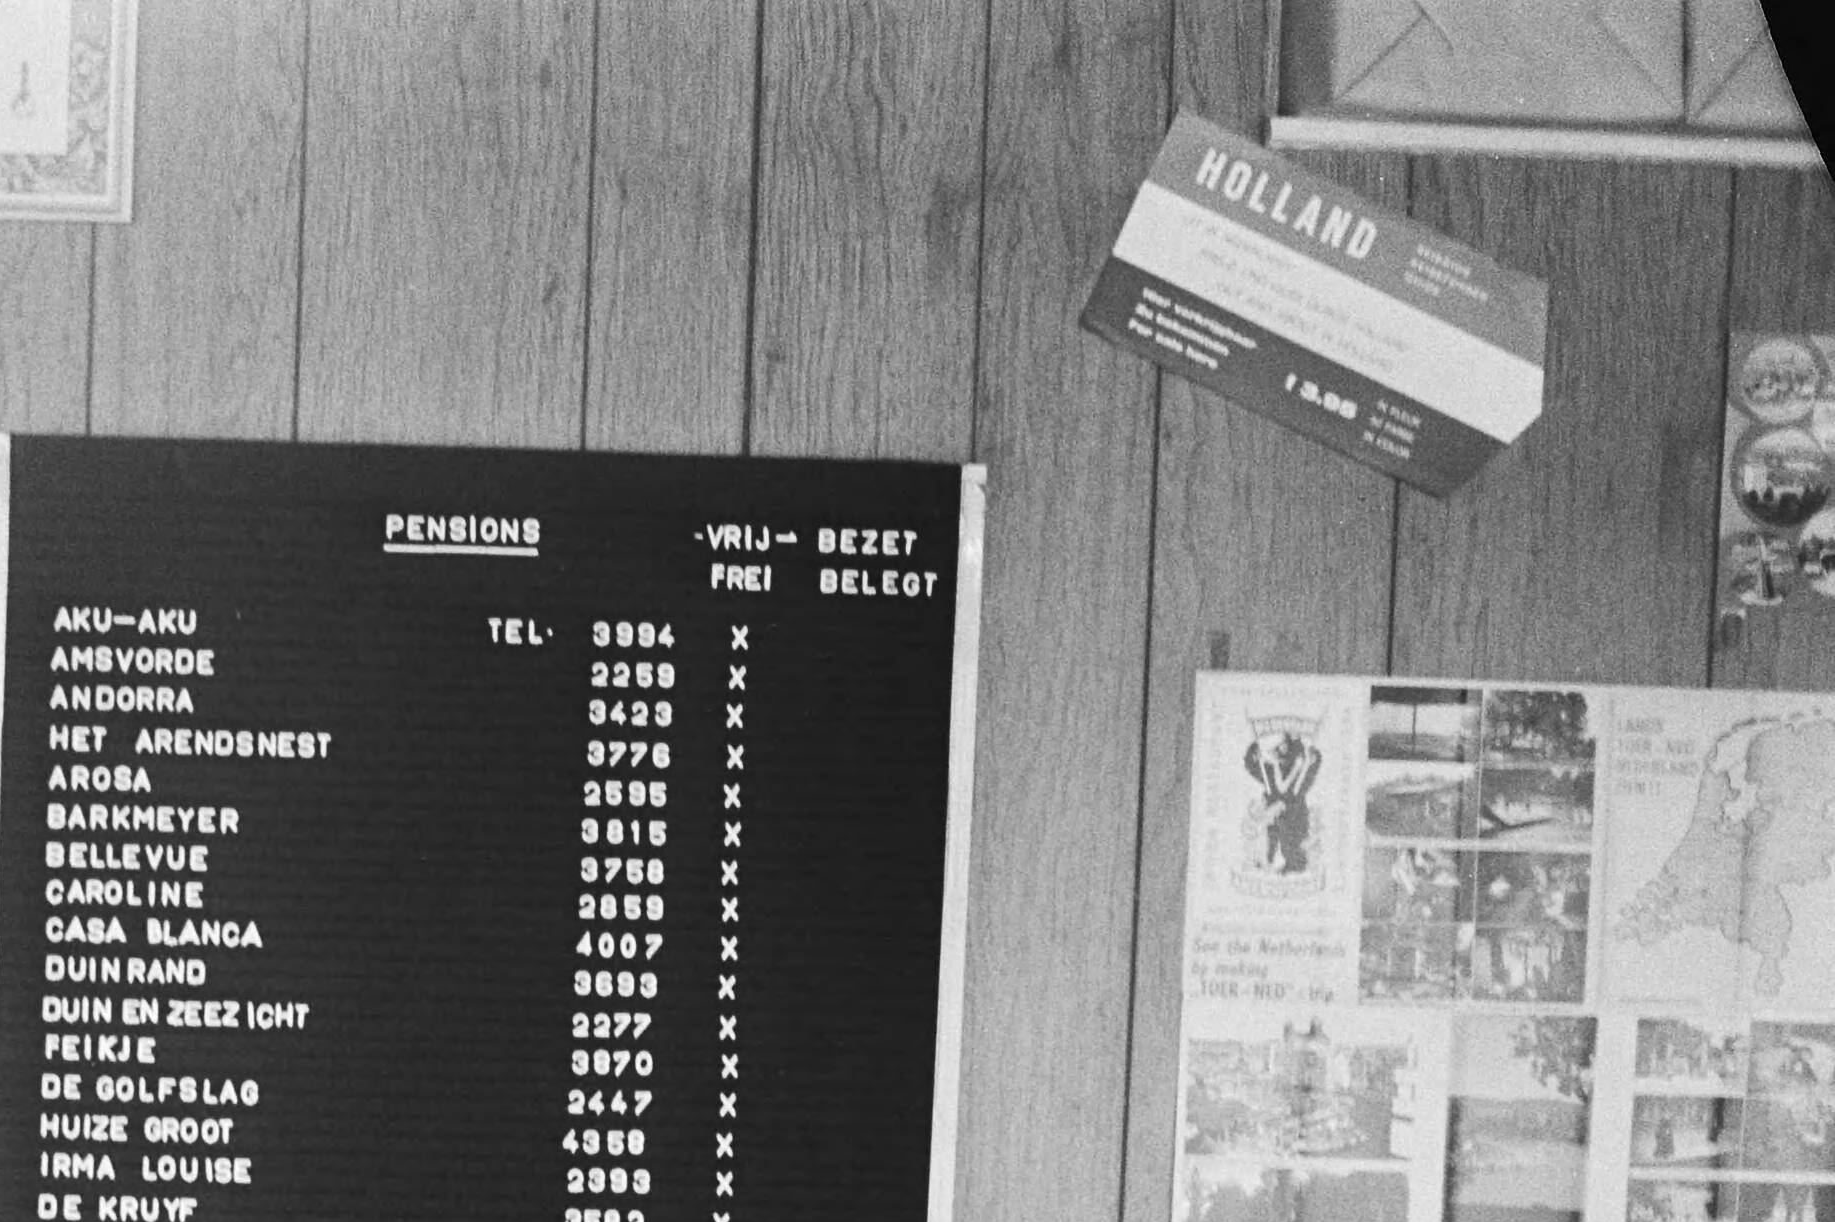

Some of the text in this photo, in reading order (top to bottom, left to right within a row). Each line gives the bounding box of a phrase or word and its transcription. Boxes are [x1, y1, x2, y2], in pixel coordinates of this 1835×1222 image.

[1196, 147, 1378, 260] HOLLAND
[385, 513, 541, 545] PENSIONS
[817, 527, 918, 556] BEZET
[710, 562, 938, 597] FREI BELEGT
[53, 605, 198, 636] AKU-AKU
[50, 645, 215, 677] AMSVORDE
[49, 683, 195, 714] ANDORRA
[588, 698, 673, 728] 3423
[49, 724, 108, 753] HET
[134, 727, 332, 759] ARENDSNEST
[47, 764, 152, 794] AROSA
[46, 802, 240, 835] BARKMEYER
[44, 840, 209, 873] BELLEVUE
[44, 877, 204, 909] CAROLINE
[45, 915, 664, 961] CASA BLANCA 4007
[44, 953, 207, 987] DUINRAND
[41, 995, 652, 1040] DUIN EN ZEEZICHT 2277
[44, 1032, 157, 1065] FEIKJE
[40, 1072, 653, 1117] DE GOLFSLAG 2447
[39, 1112, 129, 1143] HUIZE
[143, 1115, 234, 1146] GROOT
[39, 1150, 116, 1181] IRMA
[141, 1154, 252, 1185] LOUISE
[37, 1192, 83, 1222] DE
